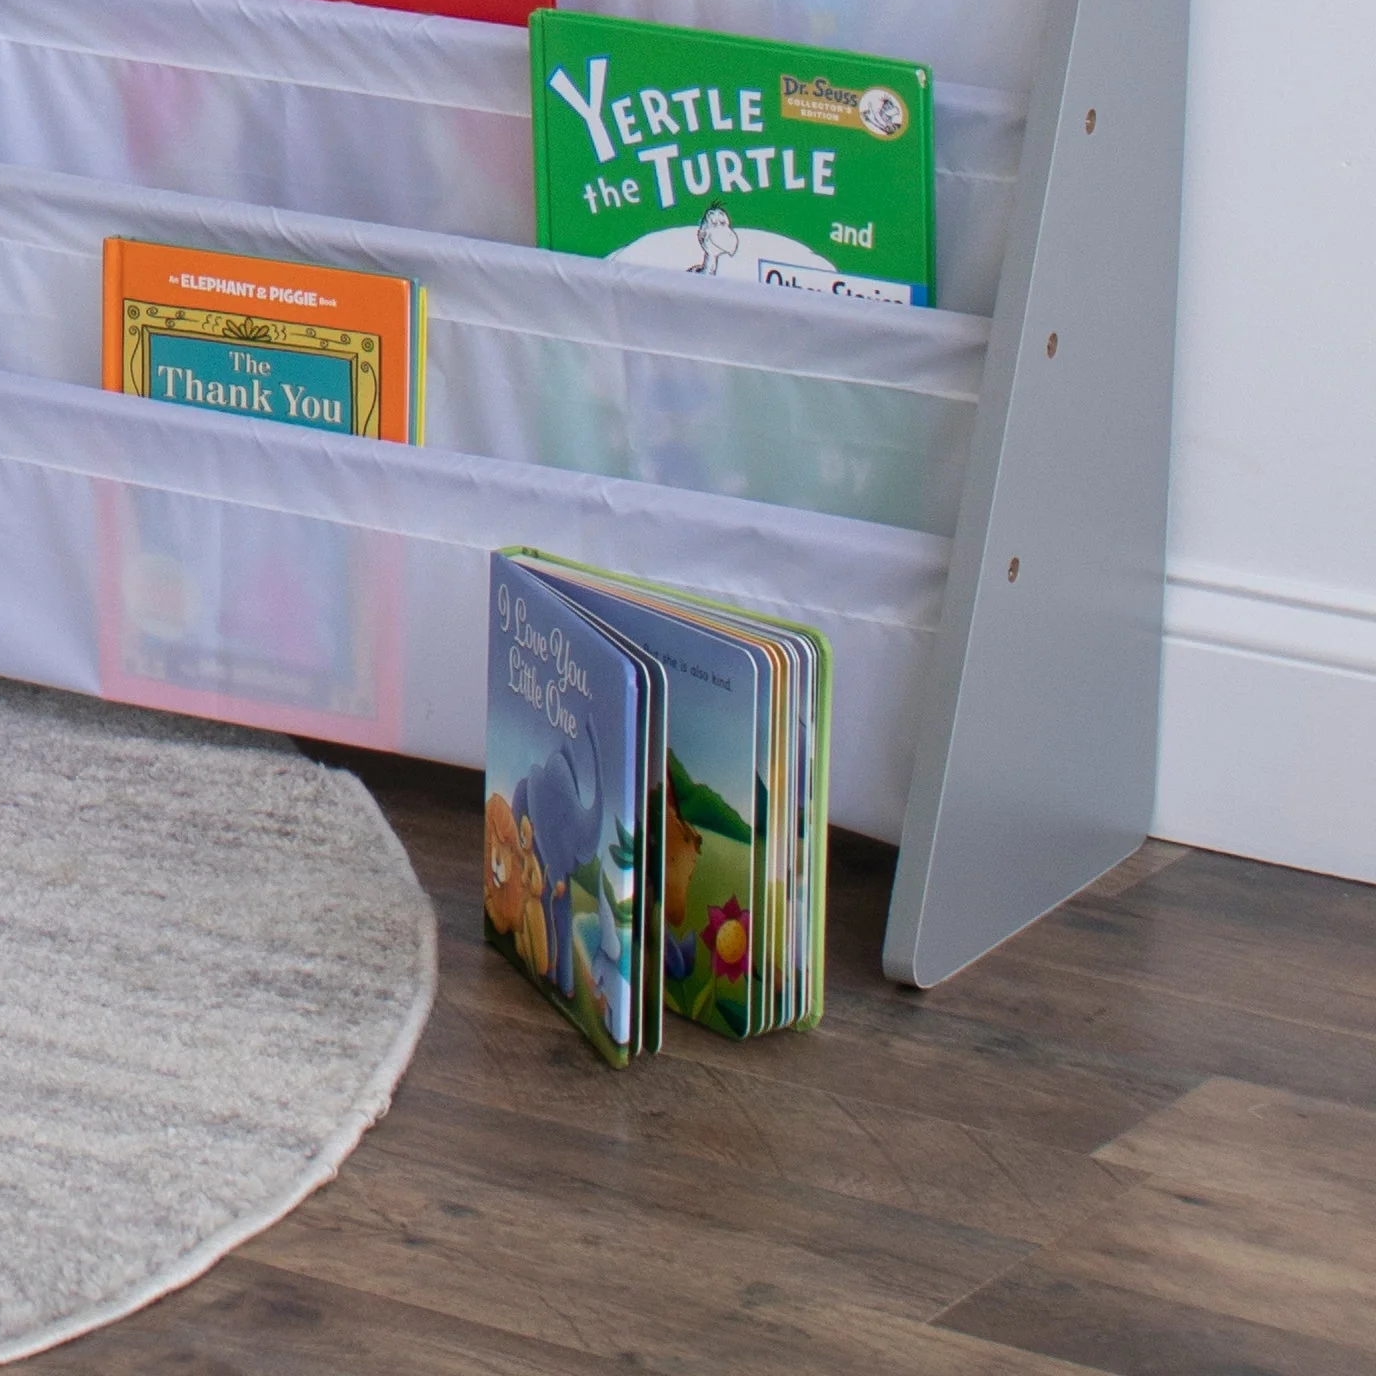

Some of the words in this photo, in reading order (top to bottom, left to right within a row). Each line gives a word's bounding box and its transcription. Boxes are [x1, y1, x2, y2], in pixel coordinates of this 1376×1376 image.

[783, 76, 809, 96] Dr.
[812, 77, 858, 107] Seuss
[786, 97, 853, 114] COLLECTOR'S
[548, 55, 764, 164] YERTLE
[800, 108, 841, 122] EDITION
[583, 176, 642, 214] the
[637, 142, 837, 210] TURTLE
[829, 221, 874, 249] and
[180, 273, 256, 298] ELEPHANT
[256, 286, 267, 300] &
[269, 285, 318, 307] PIGGIE
[228, 350, 272, 376] The
[157, 364, 273, 414] Thank
[280, 382, 343, 425] You
[498, 584, 511, 633] I
[513, 597, 549, 662] Love
[549, 627, 594, 701] You,
[507, 645, 544, 710] Little
[545, 679, 578, 739] One
